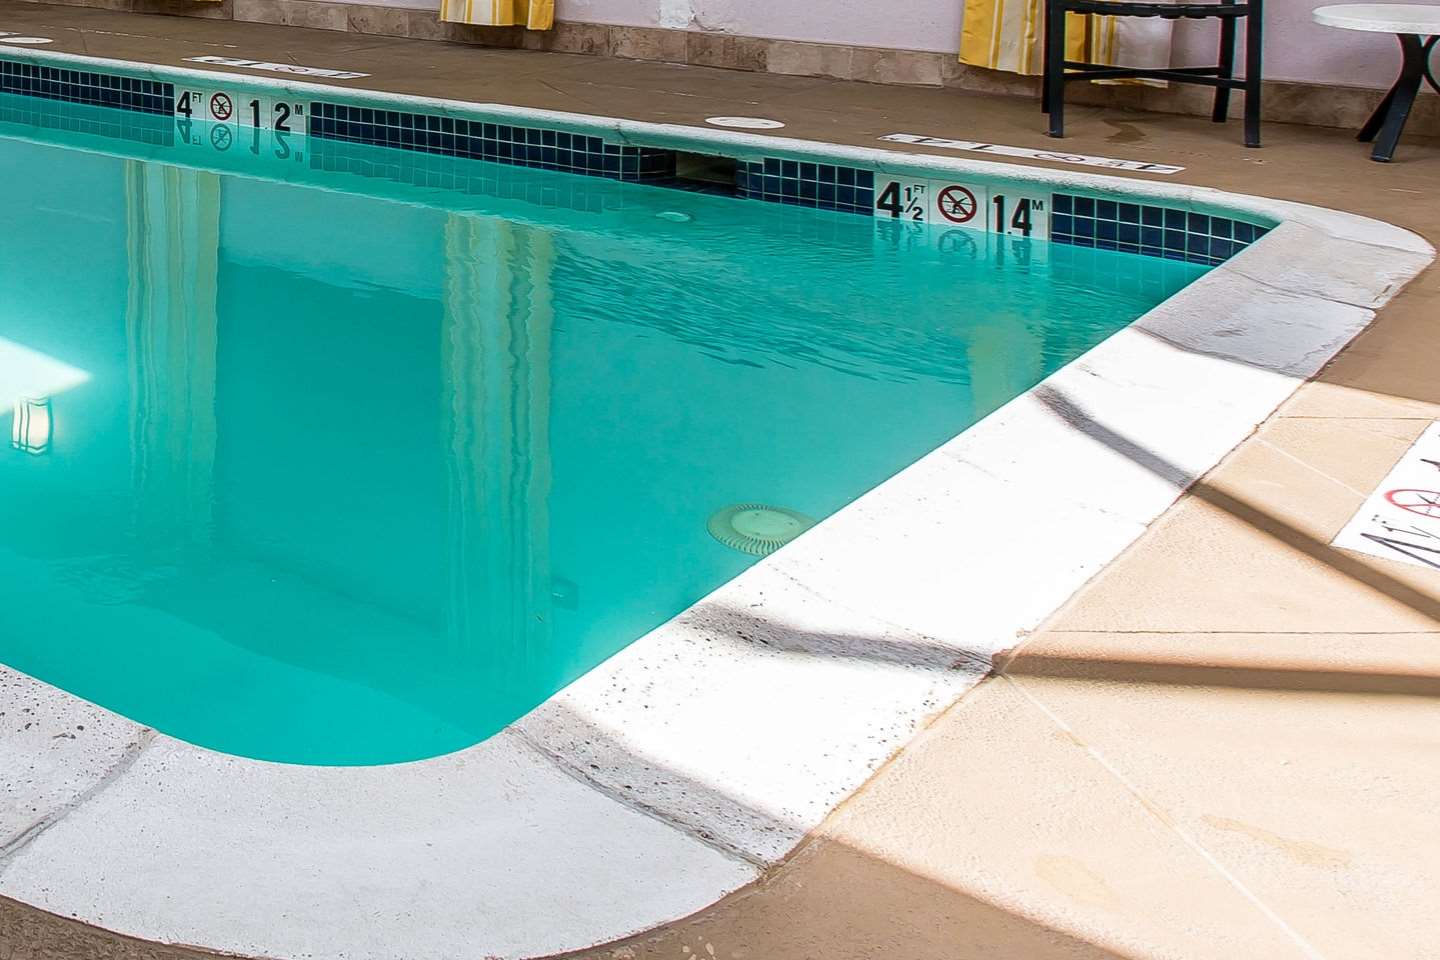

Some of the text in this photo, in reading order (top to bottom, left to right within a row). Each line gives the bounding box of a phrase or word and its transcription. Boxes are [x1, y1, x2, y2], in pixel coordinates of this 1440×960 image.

[176, 91, 193, 118] 4
[192, 92, 203, 103] FT
[294, 104, 303, 115] M
[876, 181, 903, 218] 4
[914, 184, 926, 194] FT
[1032, 199, 1044, 211] M
